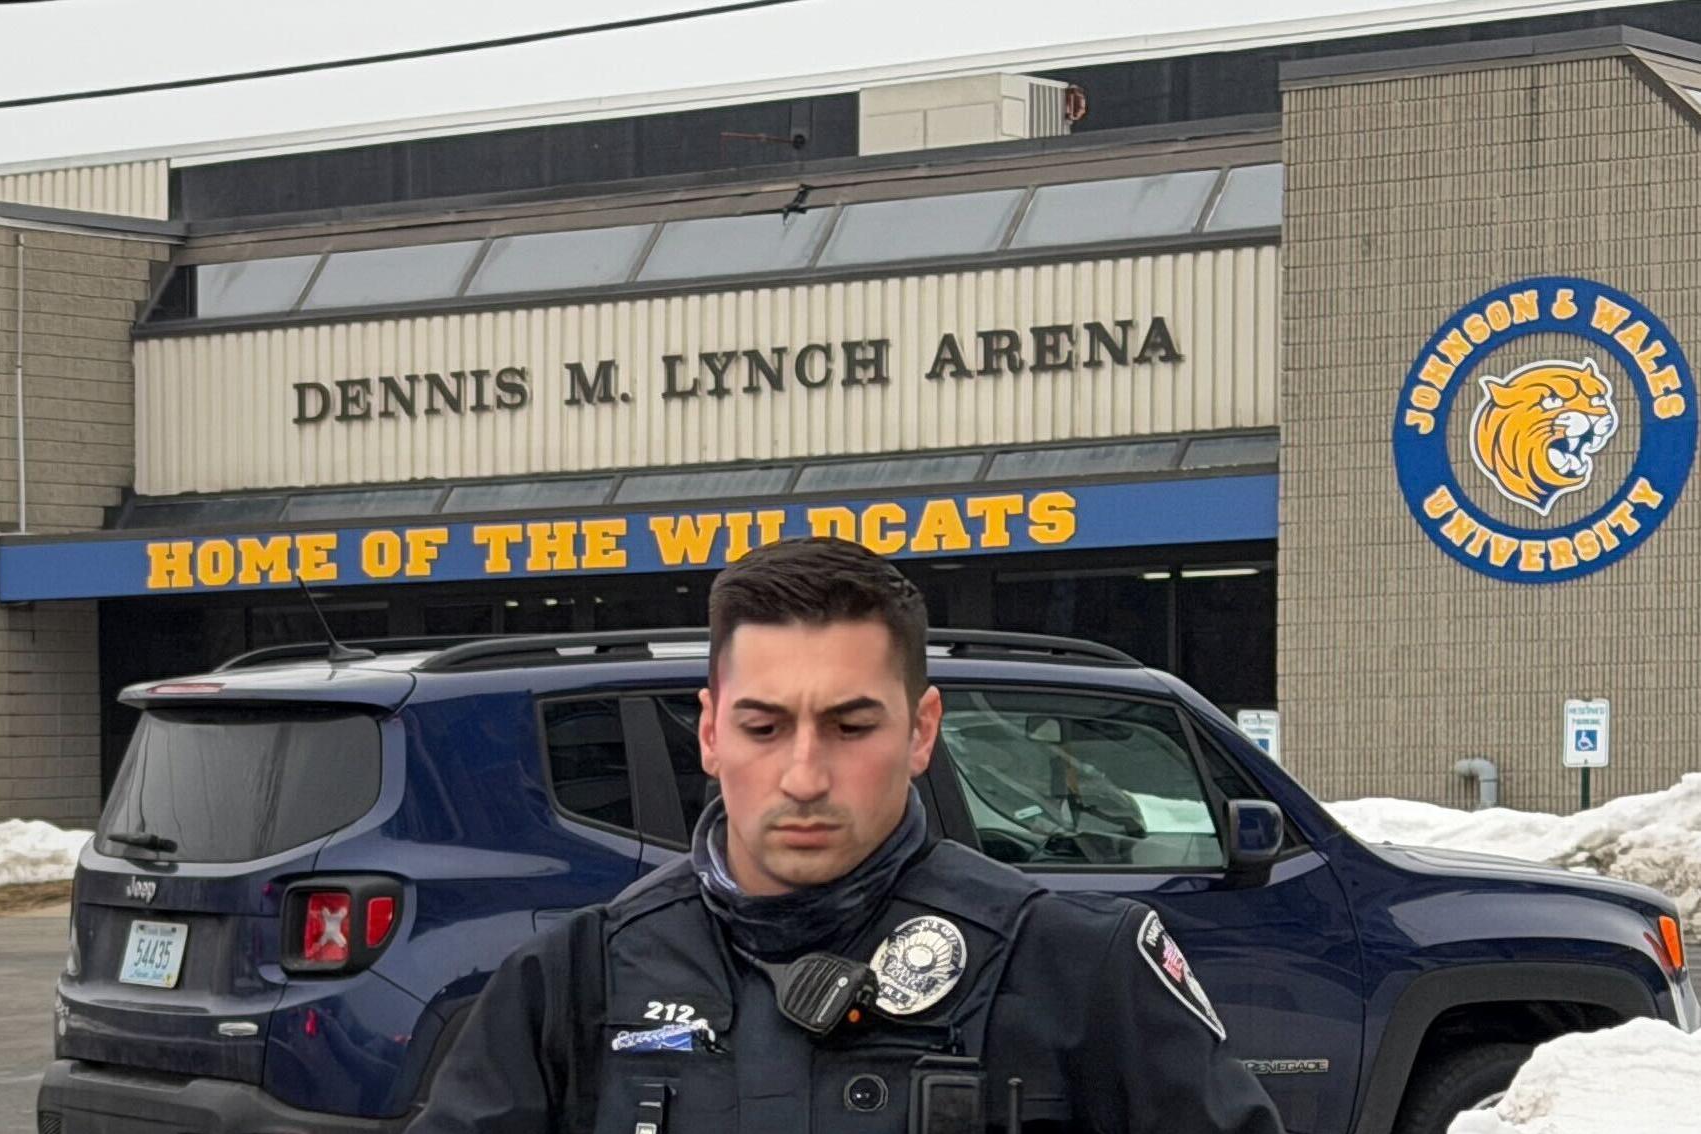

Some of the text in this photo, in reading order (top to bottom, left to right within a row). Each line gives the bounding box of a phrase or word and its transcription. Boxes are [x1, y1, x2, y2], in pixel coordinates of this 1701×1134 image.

[292, 316, 1184, 426] DENNIS M. LYNCH ARENA
[1405, 289, 1686, 435] JOHNSON & WALES
[1423, 477, 1664, 571] UNIVERSITY
[147, 535, 337, 589] HOME
[360, 528, 449, 577] OF
[473, 519, 627, 573] THE
[126, 875, 157, 903] Jeep
[134, 938, 173, 969] 54435
[643, 1001, 695, 1024] 212
[1242, 1059, 1329, 1073] RENEGADE
